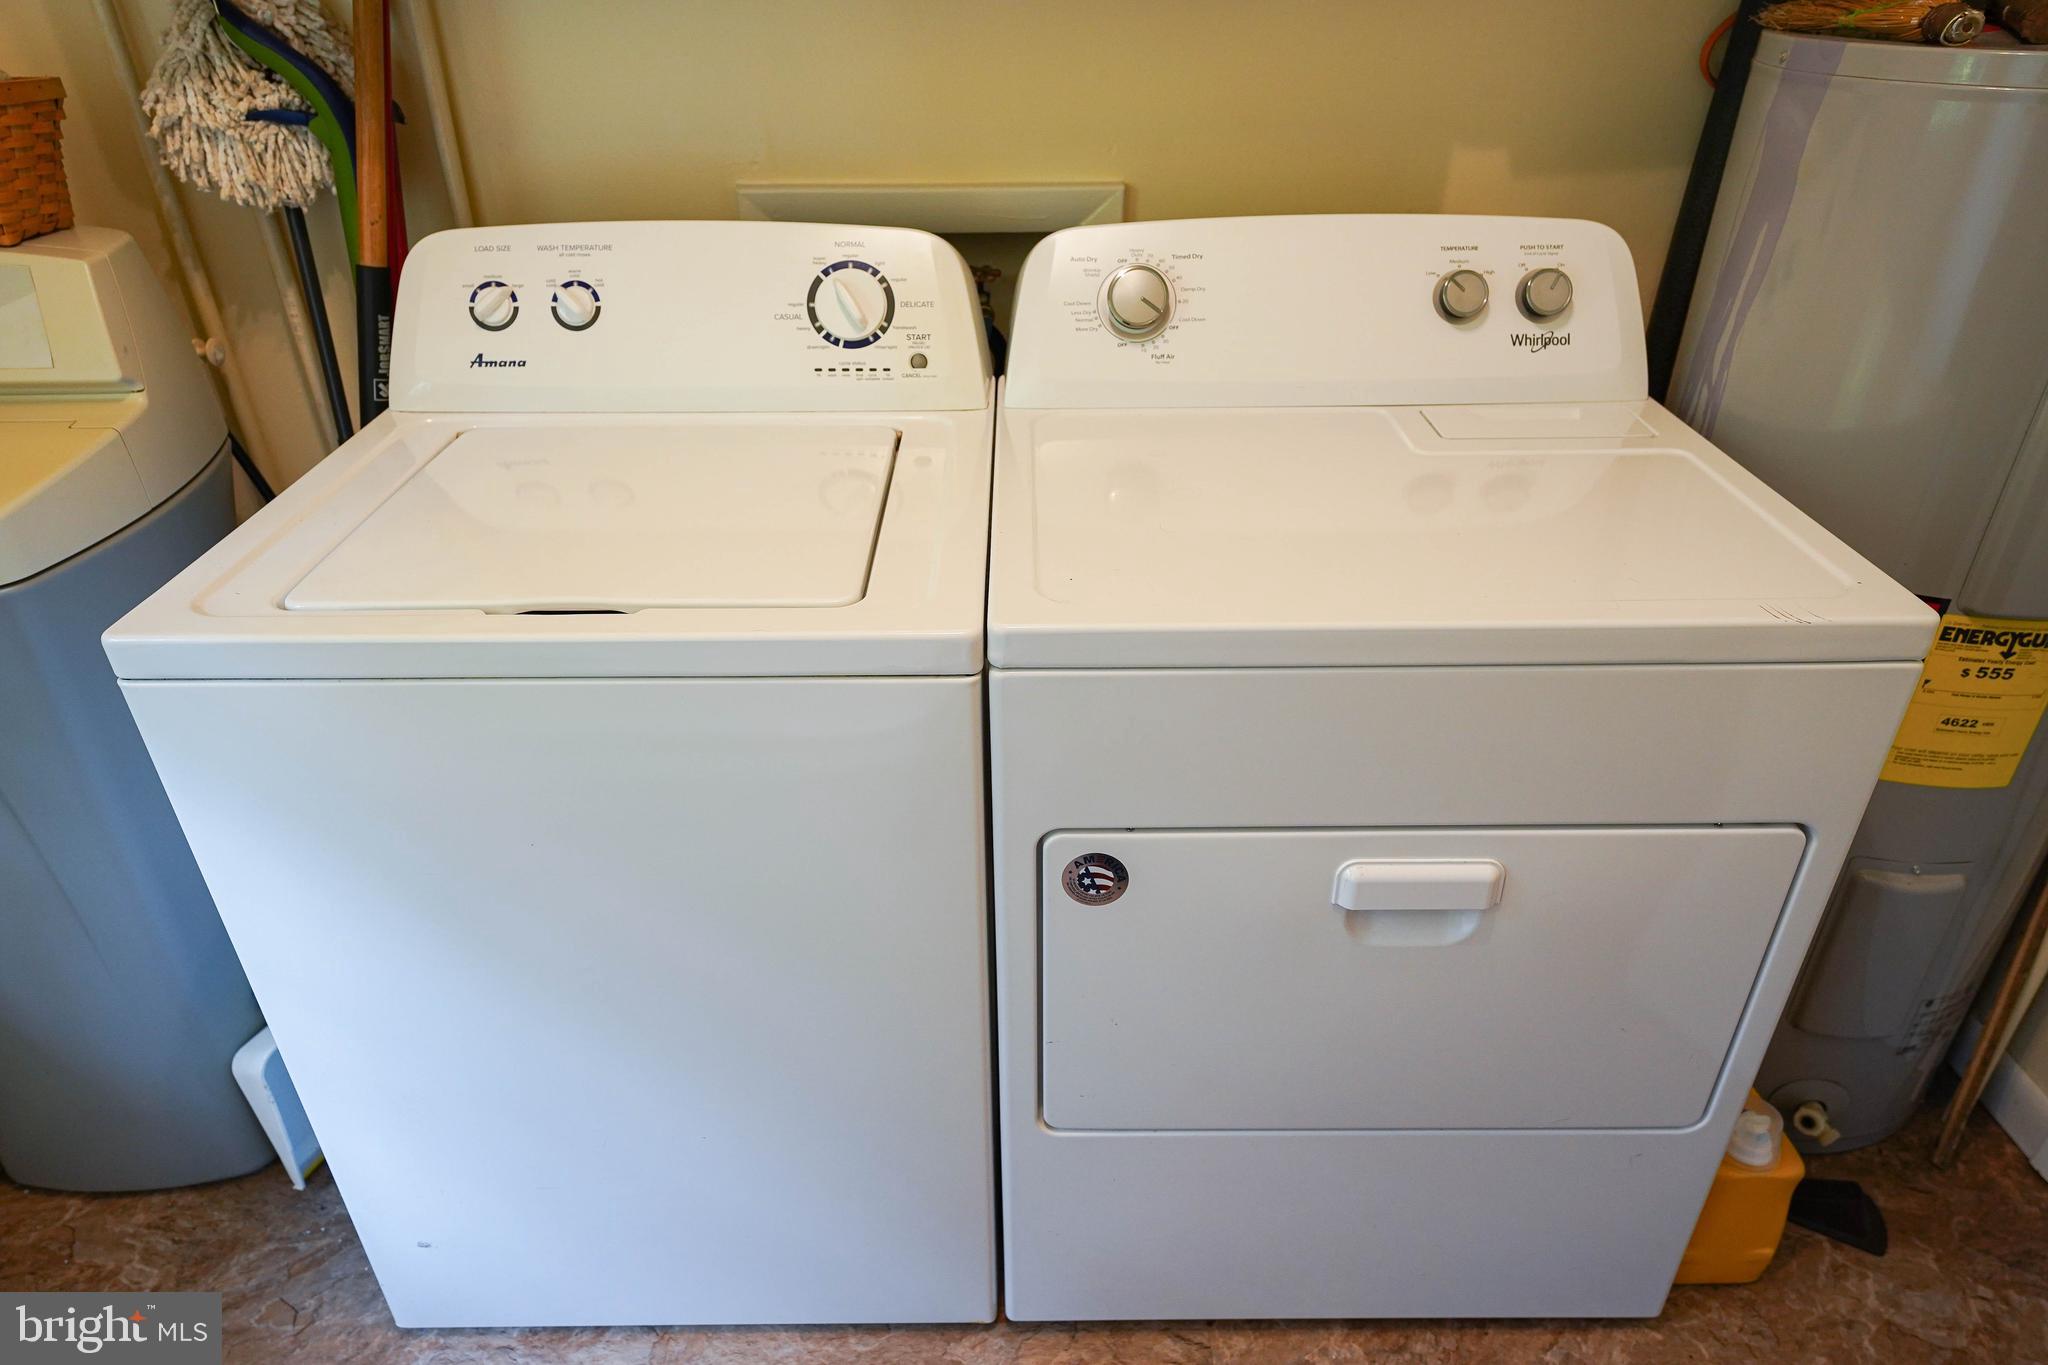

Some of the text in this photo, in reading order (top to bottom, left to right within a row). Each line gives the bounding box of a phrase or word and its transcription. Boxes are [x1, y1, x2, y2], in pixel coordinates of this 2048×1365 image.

[1086, 256, 1098, 264] Dry
[1192, 253, 1203, 261] Dry
[774, 313, 803, 321] CASUAL
[1510, 332, 1571, 351] Whirlpool
[470, 353, 527, 368] Amana
[1960, 666, 2016, 680] $ 555
[1941, 717, 1979, 728] 4622
